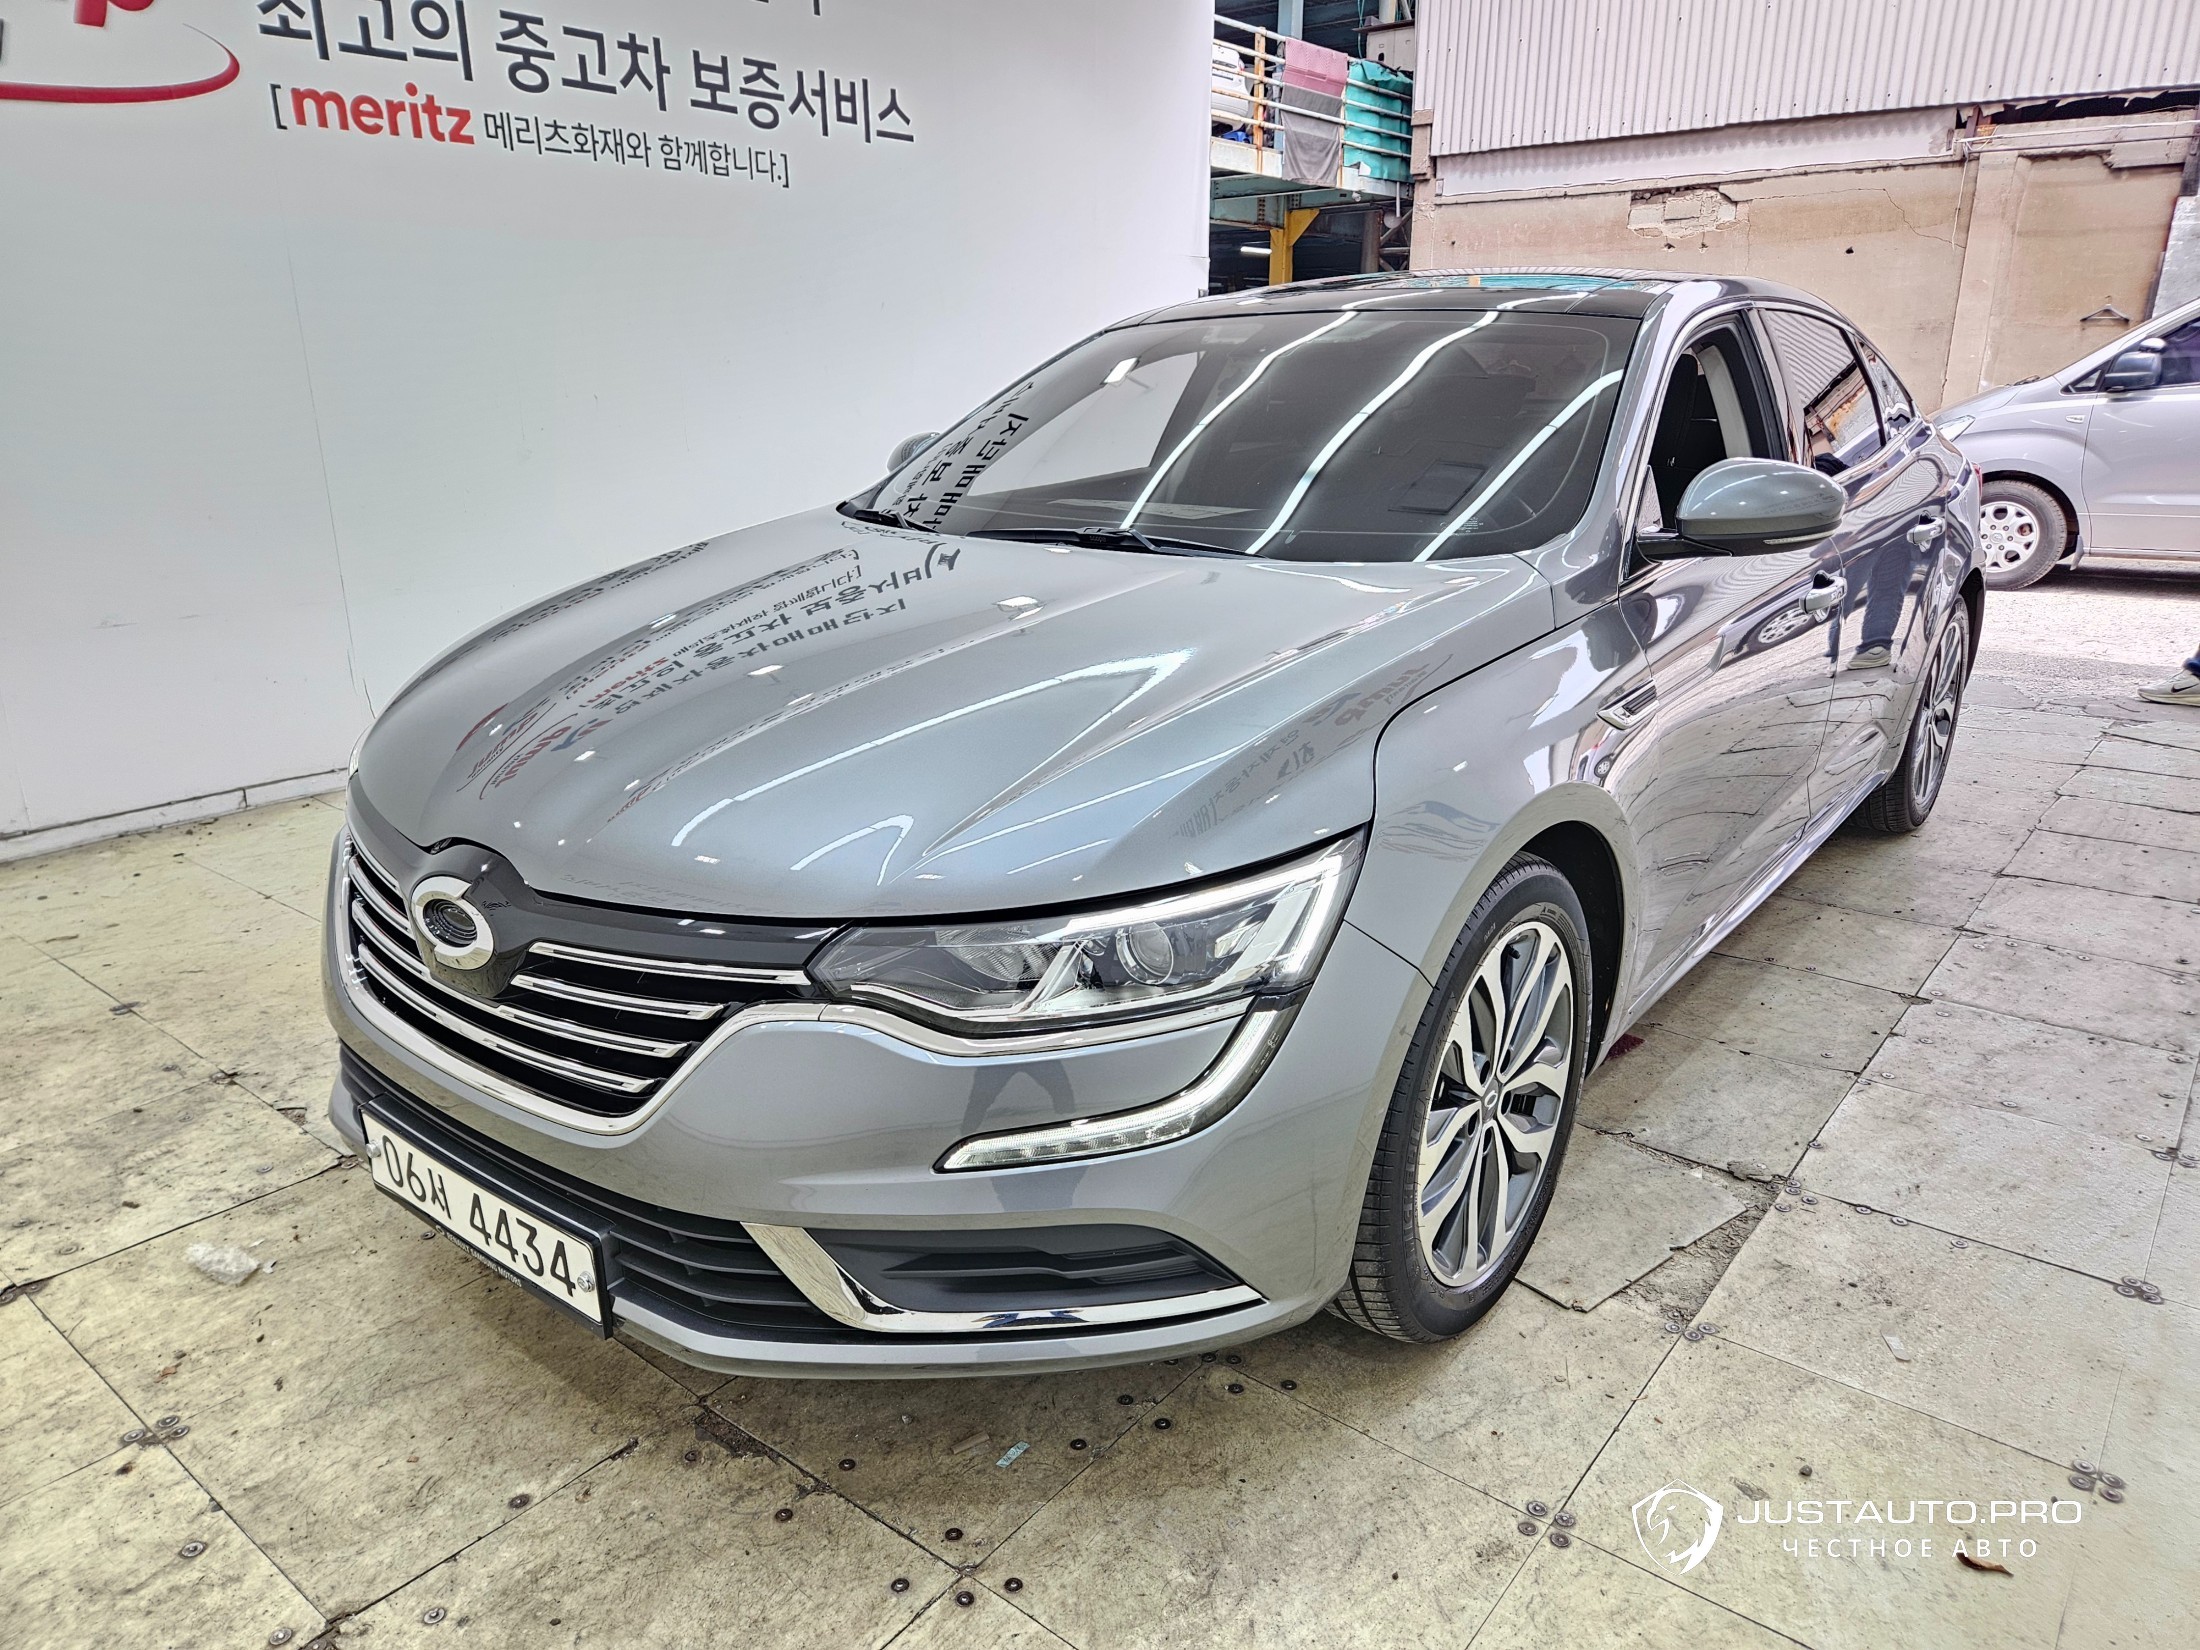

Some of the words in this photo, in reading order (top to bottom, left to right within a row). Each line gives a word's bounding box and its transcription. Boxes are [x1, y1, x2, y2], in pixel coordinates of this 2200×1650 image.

[257, 0, 473, 82] 최고의
[495, 10, 671, 112] 중고차
[690, 49, 915, 143] 보증서비스
[484, 112, 652, 168] 메리츠화재와
[657, 133, 790, 189] 함께합니다.]
[382, 1134, 452, 1220] 06서
[469, 1192, 576, 1298] 4434
